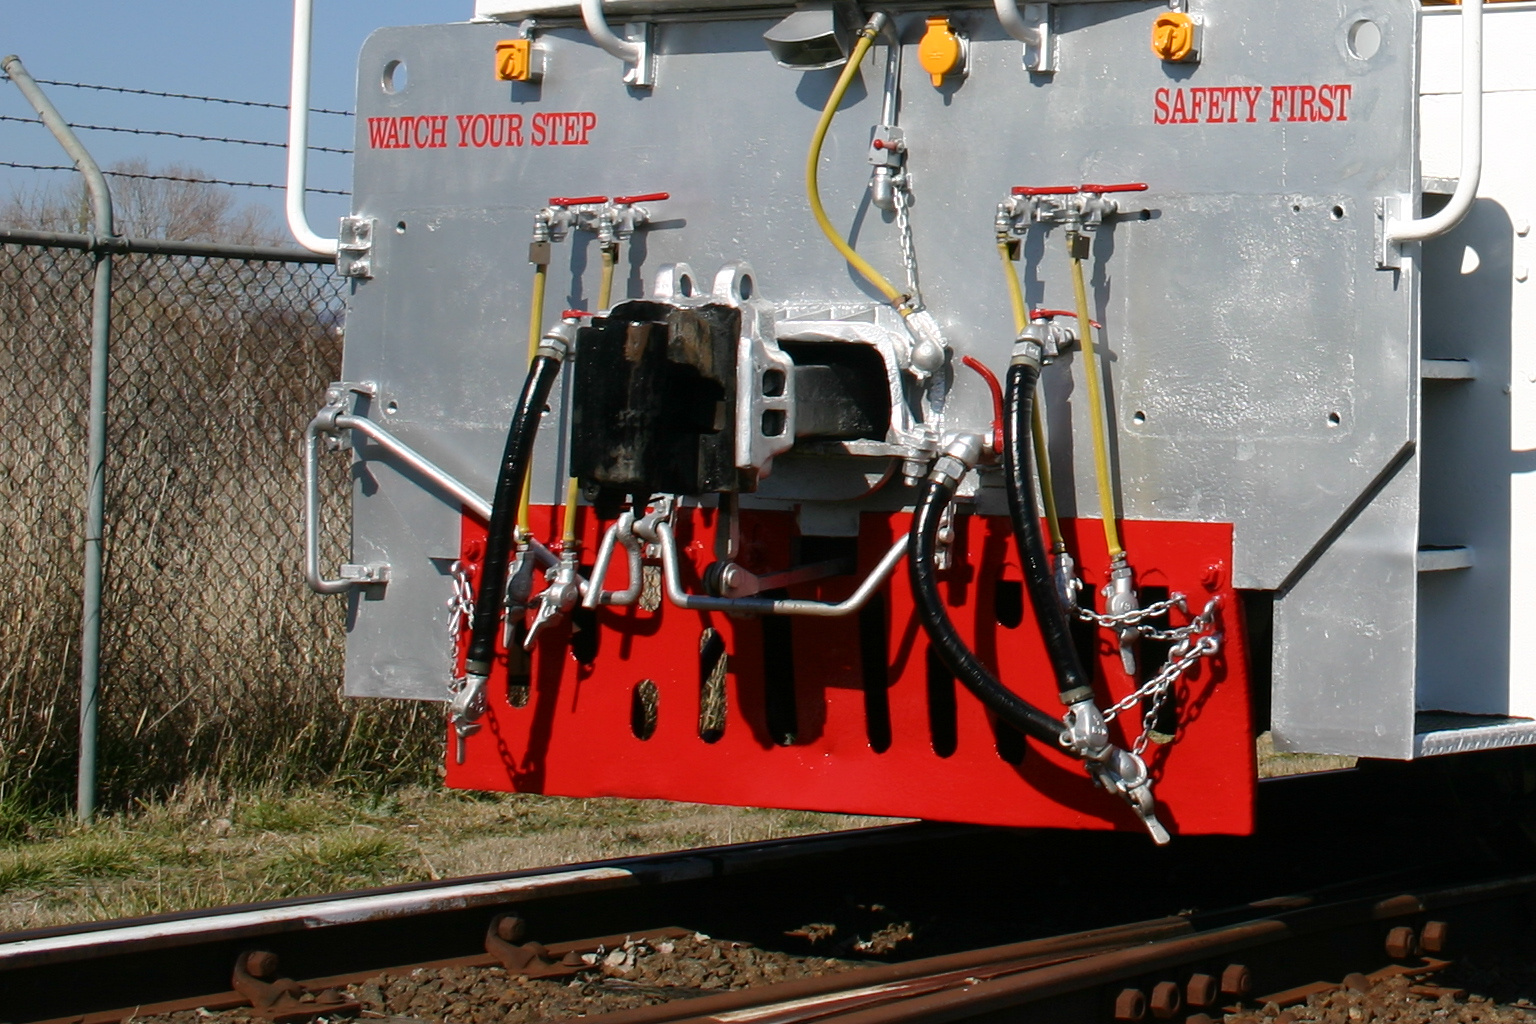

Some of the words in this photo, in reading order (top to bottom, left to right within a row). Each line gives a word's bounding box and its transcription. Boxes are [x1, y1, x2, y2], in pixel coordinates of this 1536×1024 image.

[1154, 86, 1262, 125] SAFETY
[1270, 84, 1352, 123] FIRST
[368, 115, 449, 149] WATCH
[456, 113, 524, 148] YOUR
[531, 112, 597, 147] STEP
